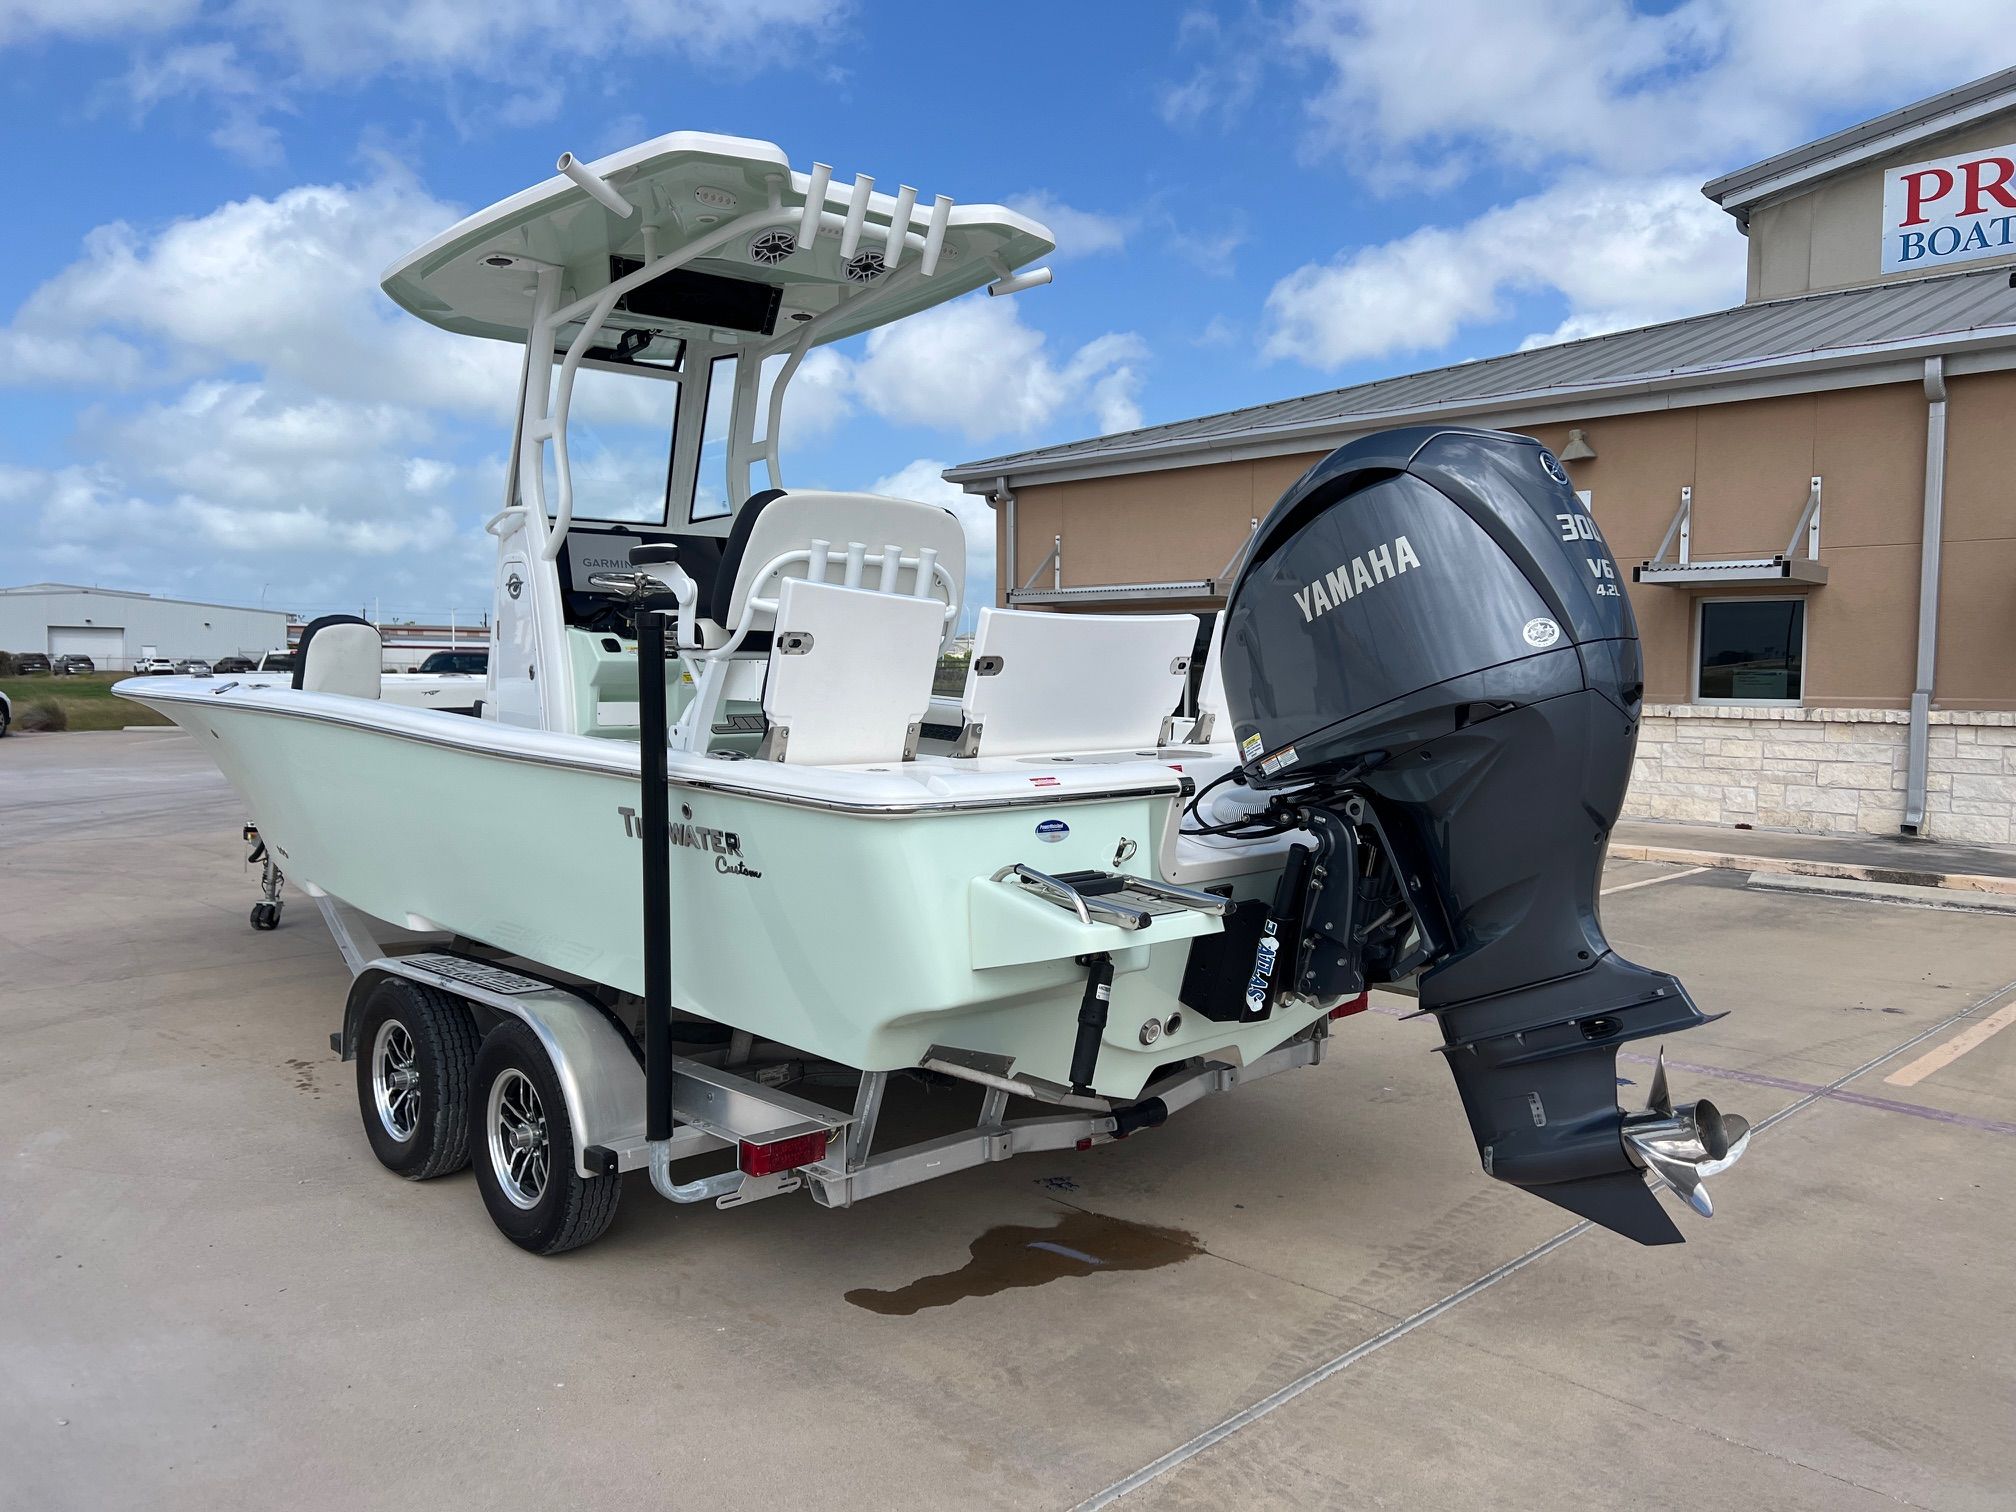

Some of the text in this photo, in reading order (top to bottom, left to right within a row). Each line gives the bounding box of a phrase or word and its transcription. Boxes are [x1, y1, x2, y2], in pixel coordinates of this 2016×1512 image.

[1899, 157, 2016, 228] PR
[1898, 215, 2016, 262] BOAT
[582, 557, 634, 569] GARMIN
[1293, 535, 1421, 623] YAMAHA
[1586, 558, 1615, 579] V6
[1596, 583, 1621, 597] 4.2L
[617, 806, 744, 858] TIWATER
[714, 855, 762, 879] Custom
[1247, 941, 1277, 1005] ATLAS
